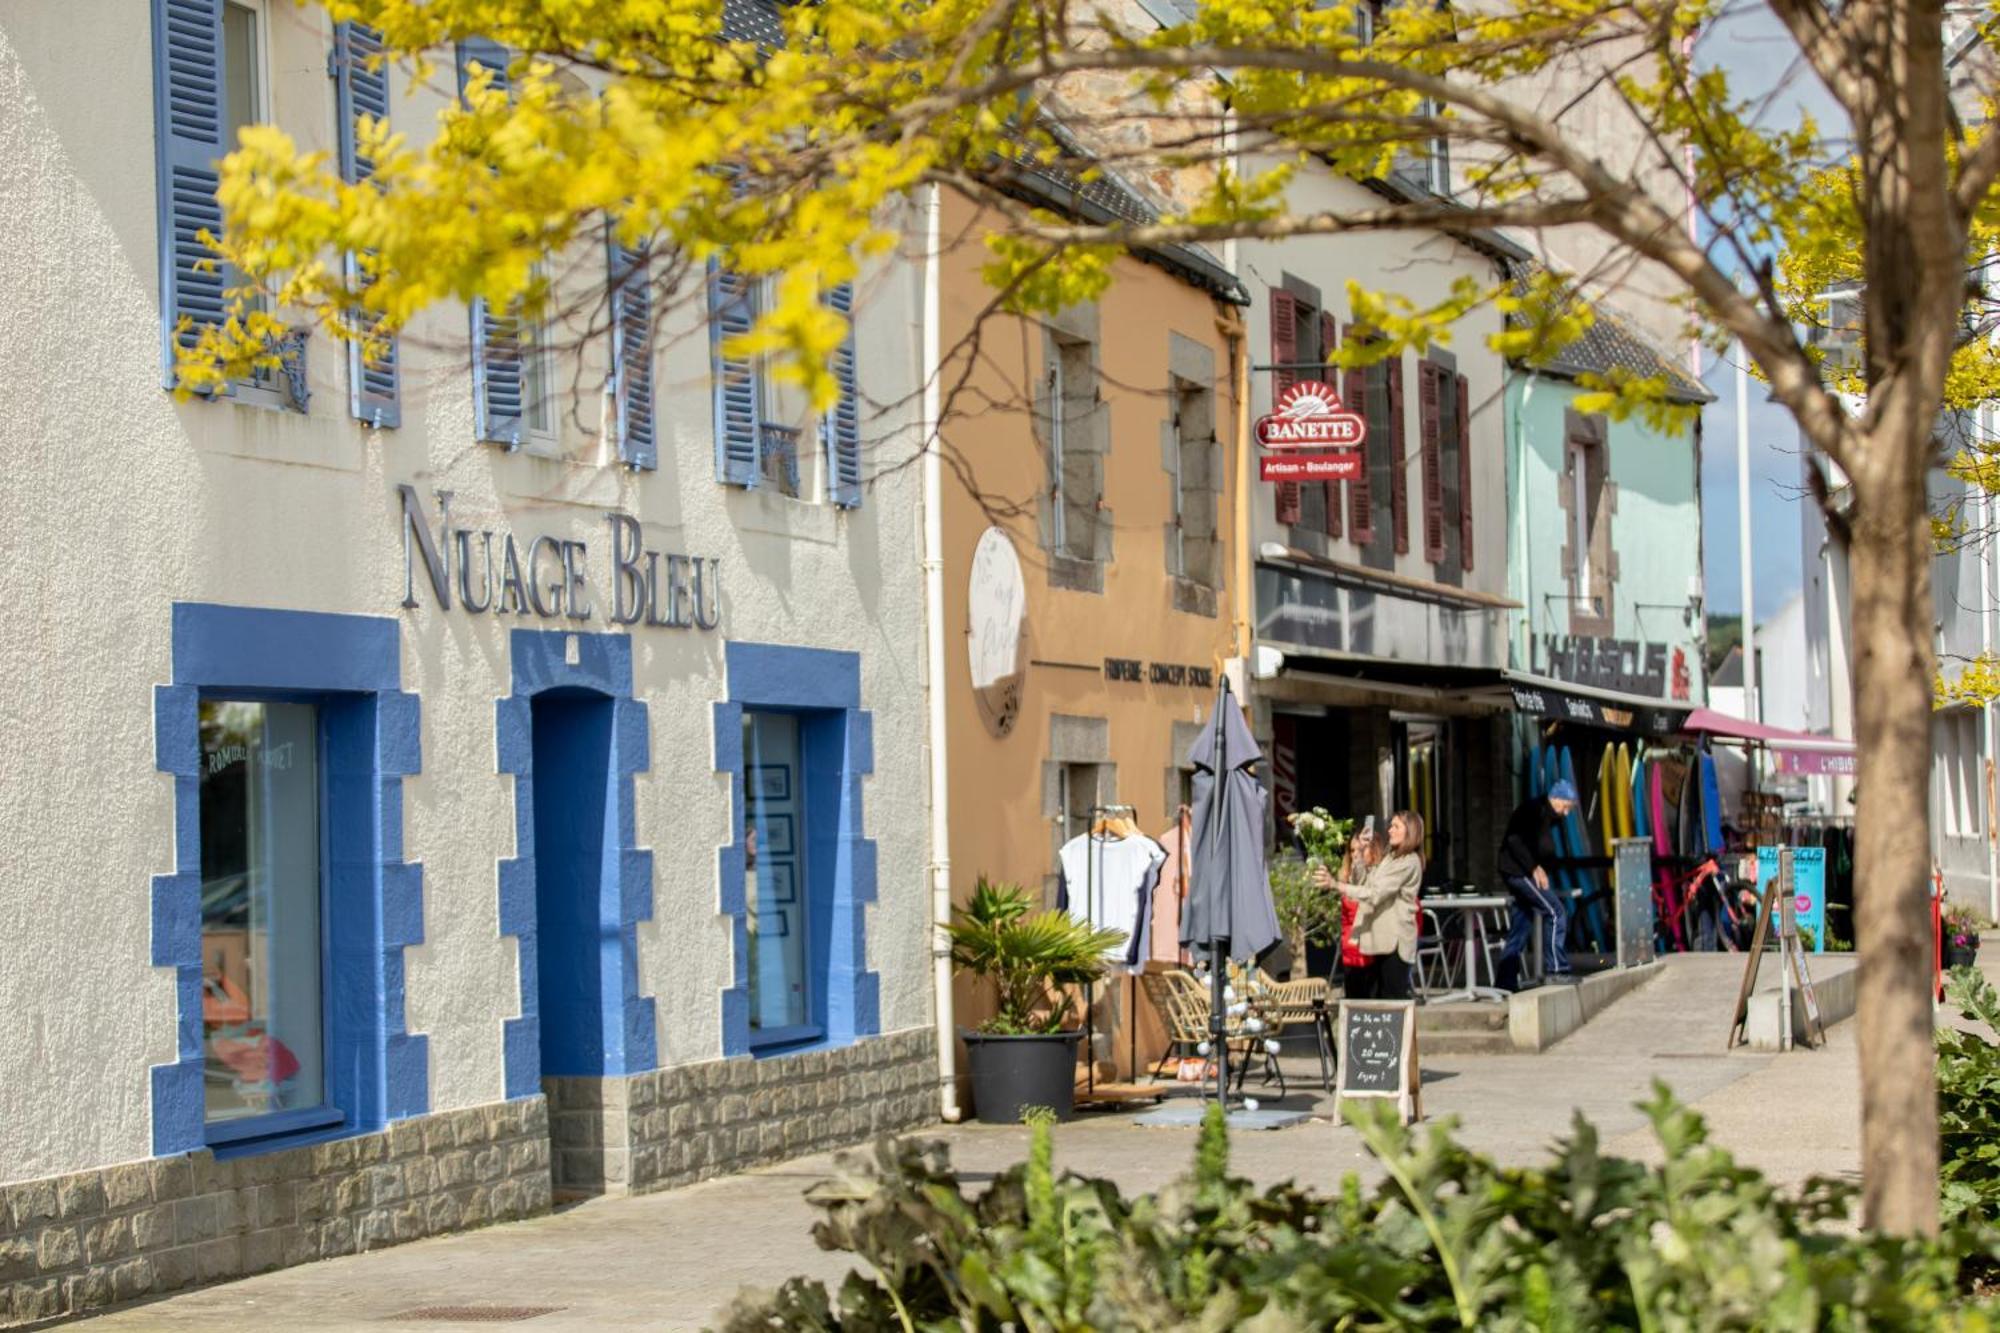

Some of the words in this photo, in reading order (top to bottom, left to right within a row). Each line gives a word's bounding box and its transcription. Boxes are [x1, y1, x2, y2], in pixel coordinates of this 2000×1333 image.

[1266, 421, 1354, 439] BANETTE
[1265, 462, 1299, 473] Artisan
[1306, 461, 1355, 476] Boulanger
[397, 484, 591, 621] NUAGE
[604, 512, 720, 630] BLEU
[1149, 661, 1187, 687] CONCEPT
[1187, 665, 1213, 689] STORE
